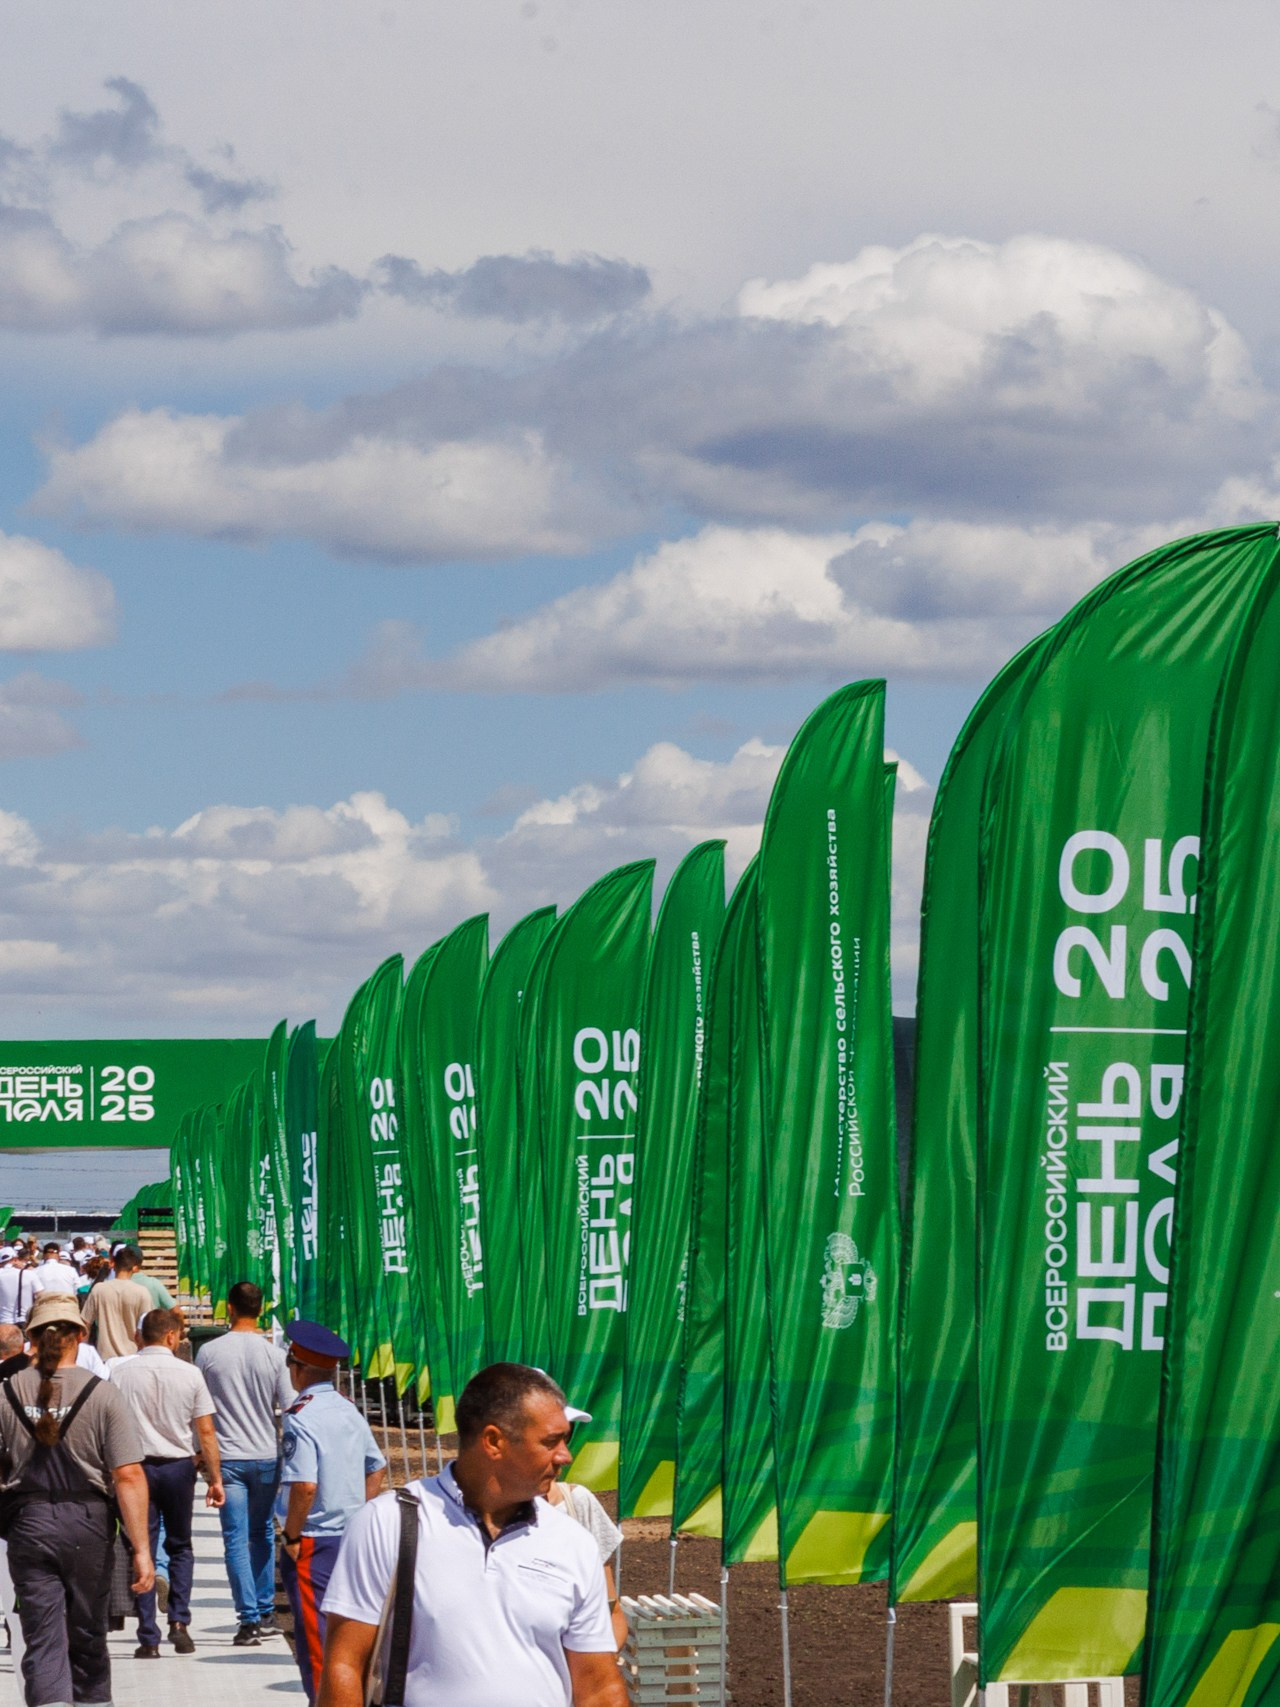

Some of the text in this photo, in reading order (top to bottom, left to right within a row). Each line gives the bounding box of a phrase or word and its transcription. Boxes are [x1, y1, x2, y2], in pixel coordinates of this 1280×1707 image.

[827, 808, 840, 916] хозяйства
[1053, 830, 1130, 999] 20
[1140, 835, 1200, 1001] 25
[829, 921, 847, 1032] сельского
[100, 1065, 155, 1092] 20
[100, 1094, 155, 1122] 25
[370, 1077, 388, 1142] 20
[444, 1062, 470, 1140] 20
[573, 1027, 609, 1120] 20
[845, 1070, 865, 1197] Российской
[575, 1154, 590, 1316] ВСЕРОССИЙСКИЙ
[589, 1153, 623, 1313] ДЕНЬ
[1042, 1061, 1069, 1352] ВСЕРОССИЙСКИЙ
[1077, 1061, 1142, 1351] ДЕНЬ
